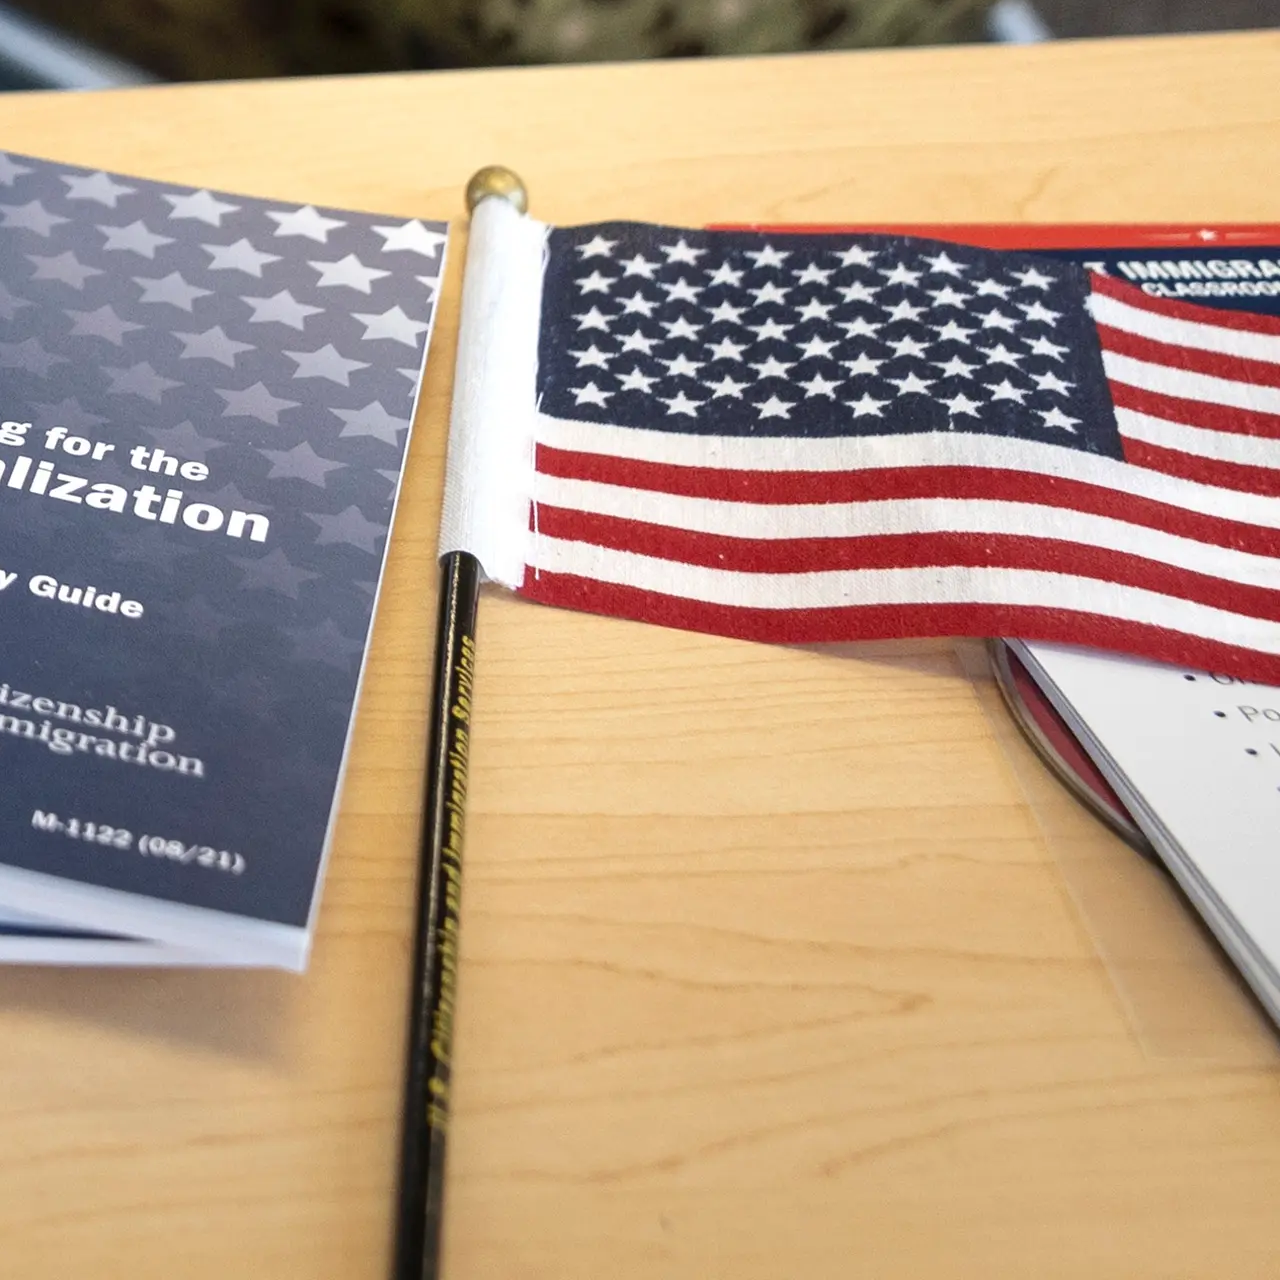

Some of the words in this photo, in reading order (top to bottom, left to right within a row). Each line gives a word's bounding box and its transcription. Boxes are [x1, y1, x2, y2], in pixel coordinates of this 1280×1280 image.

[1116, 259, 1280, 279] IMMIGRA
[44, 426, 116, 462] for
[129, 445, 210, 481] the
[28, 574, 145, 619] Guide
[451, 635, 475, 725] Services
[30, 809, 133, 851] M-1122
